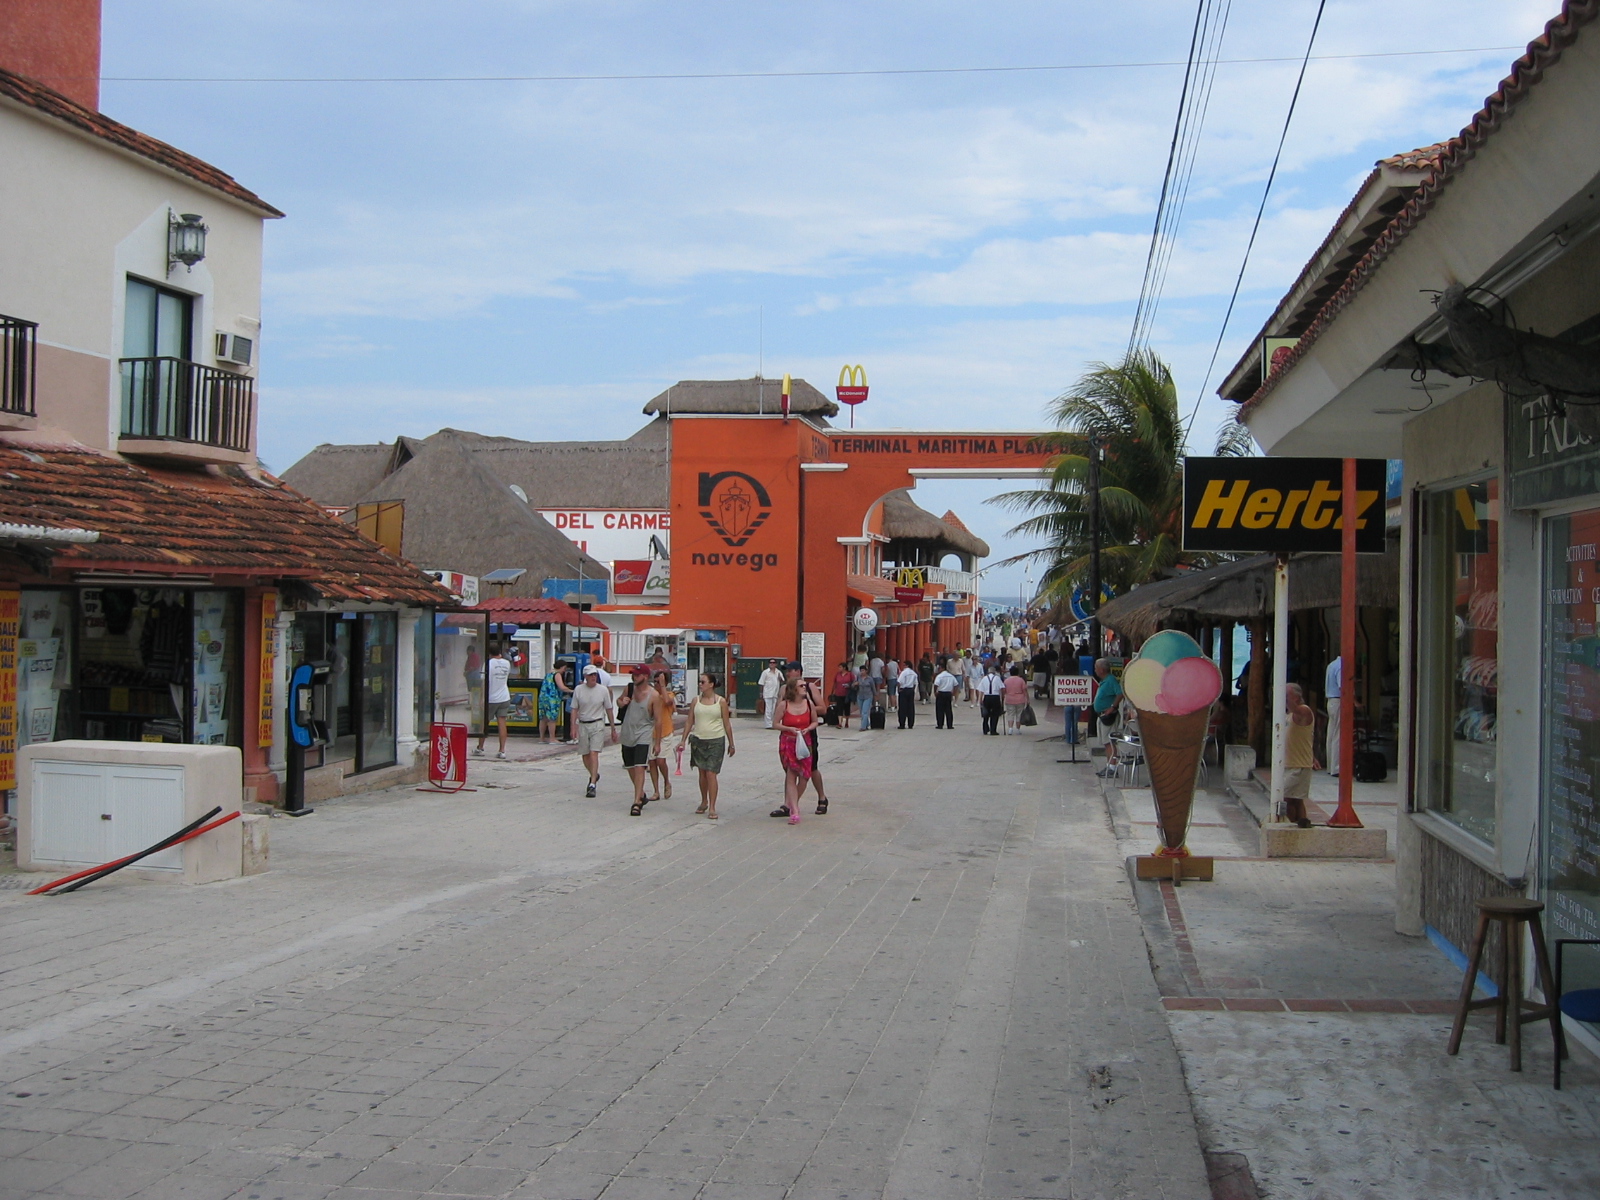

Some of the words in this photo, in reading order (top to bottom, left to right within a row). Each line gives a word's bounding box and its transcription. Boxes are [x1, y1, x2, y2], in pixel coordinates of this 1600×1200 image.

[832, 439, 912, 454] TERMINAL
[918, 439, 998, 454] MARITIMA
[1191, 479, 1379, 530] Hertz
[556, 513, 595, 529] DEL
[691, 552, 778, 572] navega
[1565, 543, 1597, 563] ACTIVITIES
[1577, 567, 1585, 583] &
[855, 618, 875, 627] HSBC
[1058, 678, 1088, 686] MONEY
[1555, 892, 1567, 910] ASK
[1569, 899, 1581, 919] FOR
[1553, 910, 1577, 938] SPECIAL
